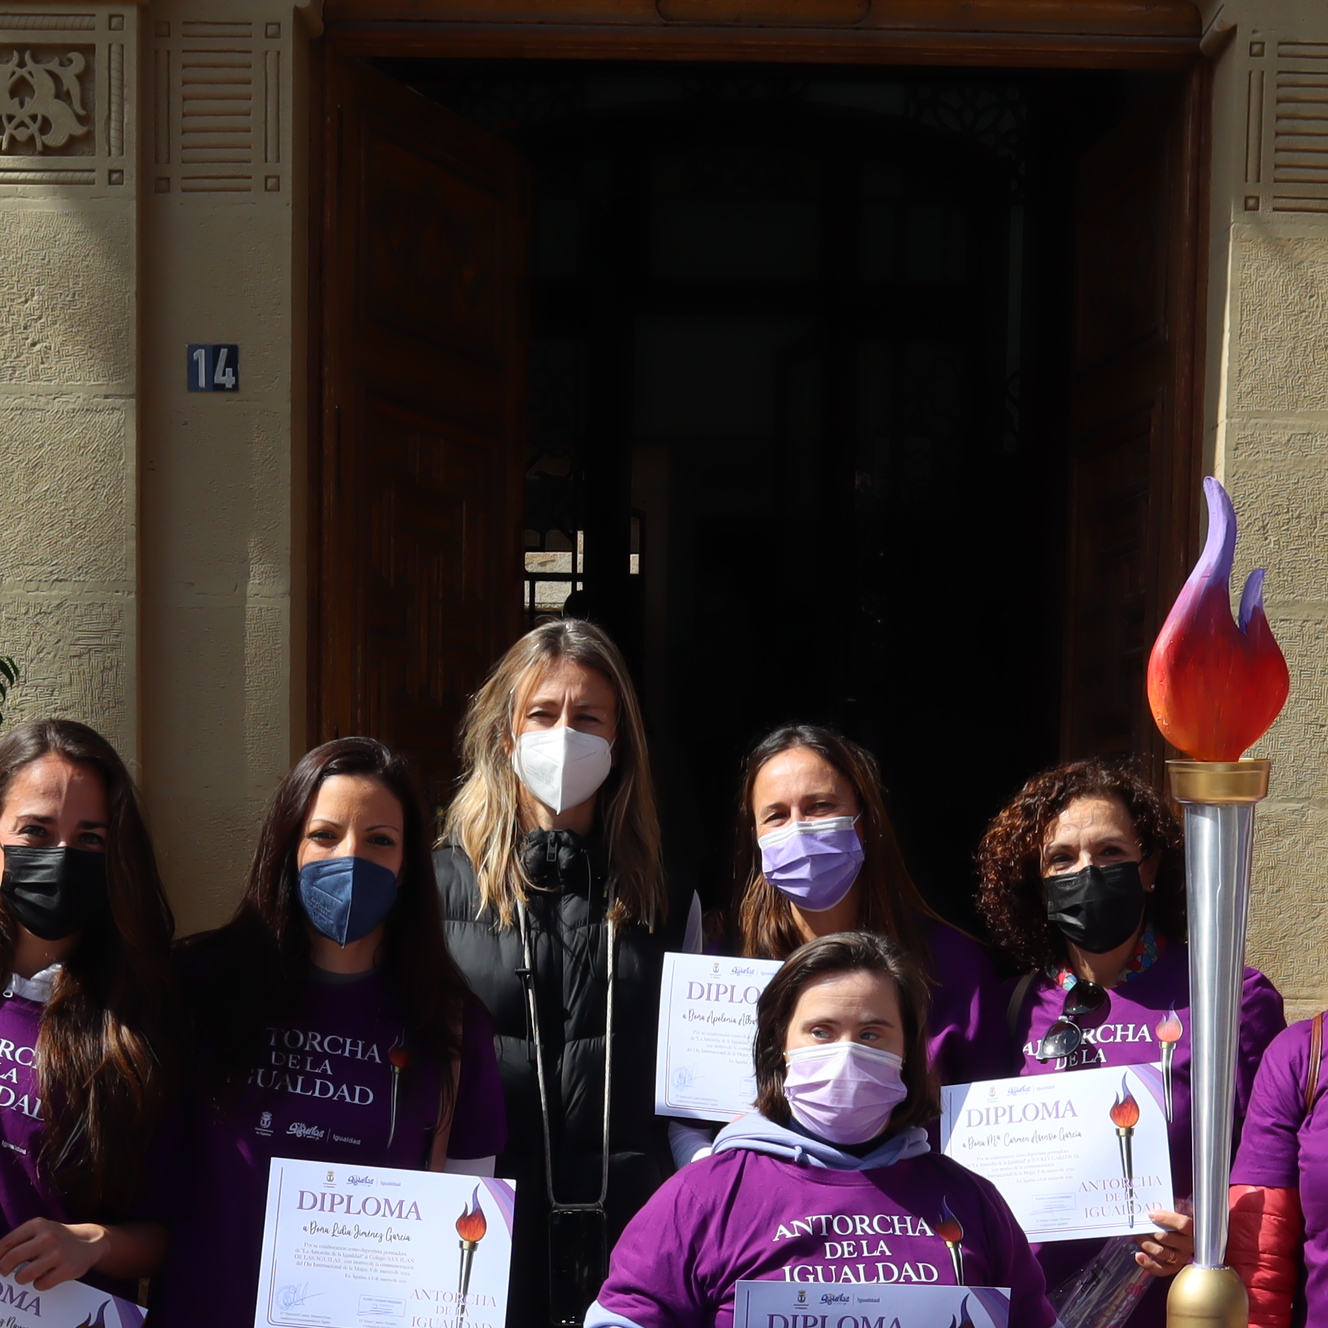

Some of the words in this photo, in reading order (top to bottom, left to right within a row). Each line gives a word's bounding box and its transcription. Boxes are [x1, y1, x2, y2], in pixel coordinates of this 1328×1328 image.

[193, 348, 236, 388] 14
[266, 1027, 382, 1064] TORCHA
[272, 1051, 301, 1069] DE
[305, 1056, 333, 1075] LA
[1055, 1052, 1078, 1070] DE
[1081, 1048, 1107, 1064] LA
[965, 1099, 1078, 1128] DIPLOMA
[332, 1134, 361, 1145] Igualdad
[1078, 1176, 1163, 1193] ANTORCHA
[296, 1190, 423, 1221] DIPLOMA
[1105, 1193, 1120, 1202] DE
[1085, 1202, 1163, 1218] IGUALDAD
[384, 1227, 413, 1243] García
[772, 1214, 934, 1242] ANTORCHA
[824, 1240, 858, 1260] DE
[861, 1239, 892, 1257] LA
[782, 1262, 939, 1284] IGUALDAD
[410, 1288, 497, 1308] ANTORCHA
[435, 1304, 452, 1315] DE
